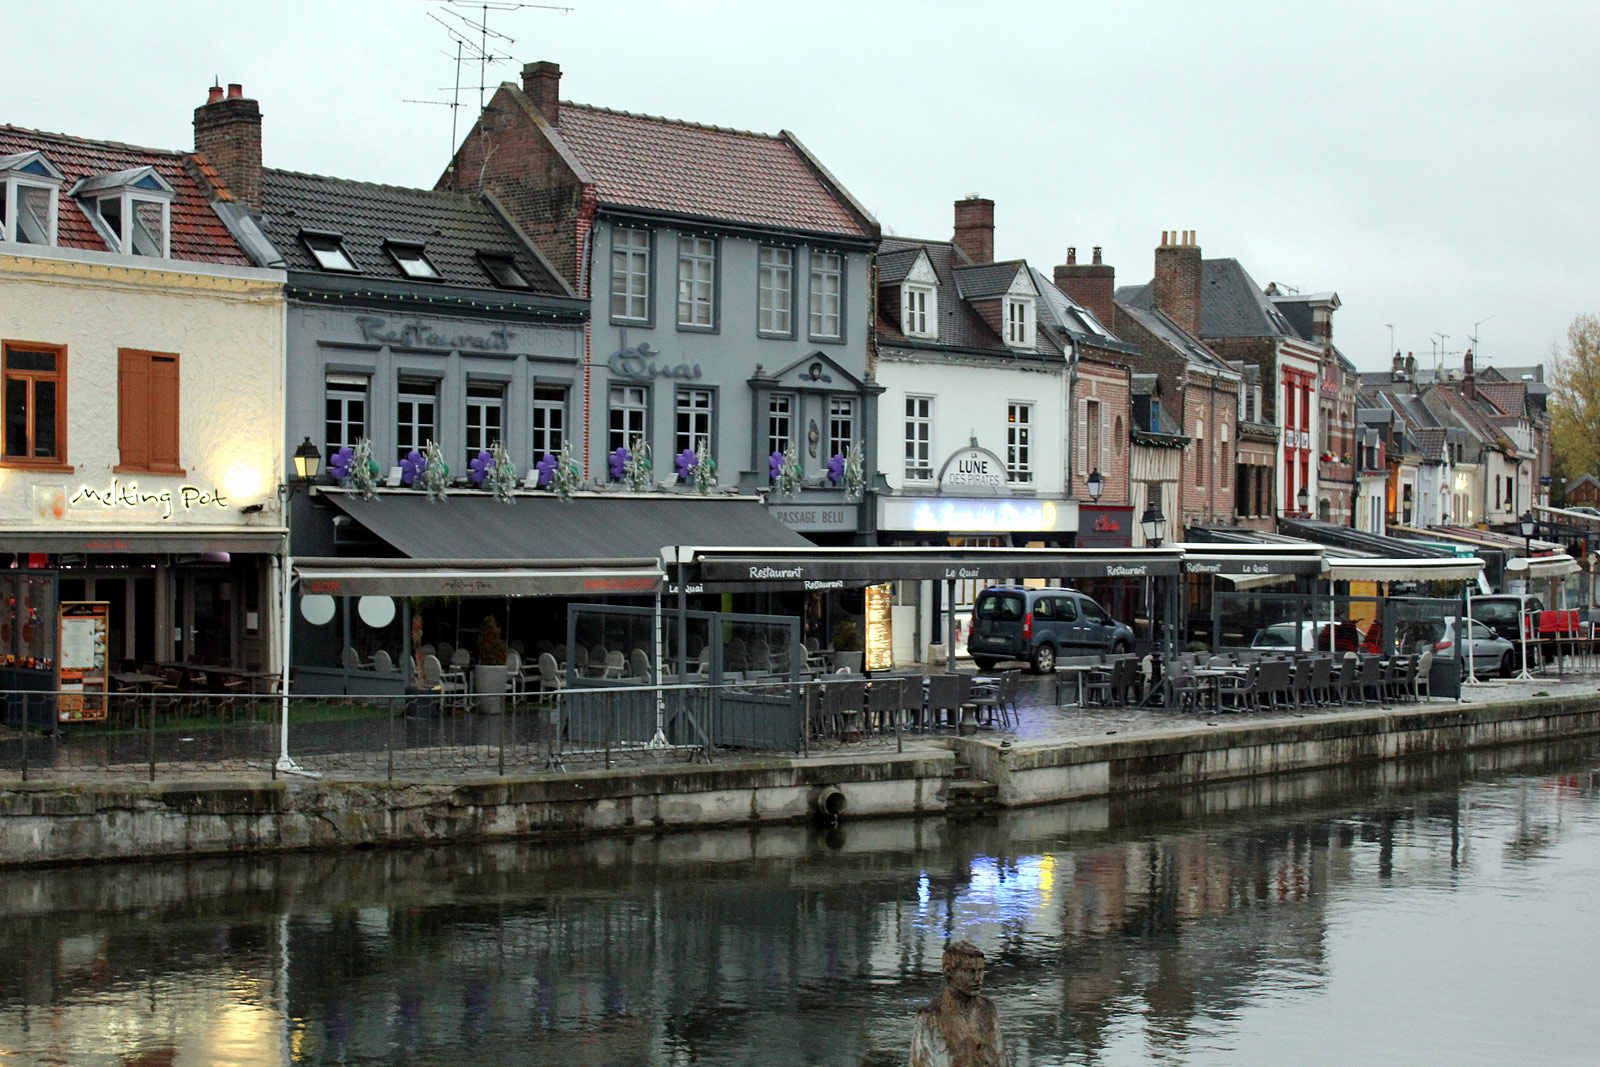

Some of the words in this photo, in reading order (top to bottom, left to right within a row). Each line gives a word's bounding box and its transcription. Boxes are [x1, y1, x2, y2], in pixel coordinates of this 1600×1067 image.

[355, 315, 517, 350] Restaurant
[619, 328, 660, 358] Le
[608, 351, 703, 380] Quai
[959, 460, 988, 474] LUNE
[949, 472, 966, 485] DES
[967, 473, 1000, 486] PIRATES
[72, 479, 172, 520] Melting
[181, 486, 228, 509] Pot
[776, 511, 817, 524] PASSAGE
[822, 511, 844, 524] BELU
[749, 566, 804, 579] Restaurant
[945, 568, 956, 578] Le
[958, 567, 980, 578] Quai
[1106, 565, 1148, 576] Restaurant
[1185, 562, 1223, 573] Restaurant
[1242, 564, 1251, 573] Le
[1253, 563, 1269, 574] Quai
[668, 584, 679, 593] Le
